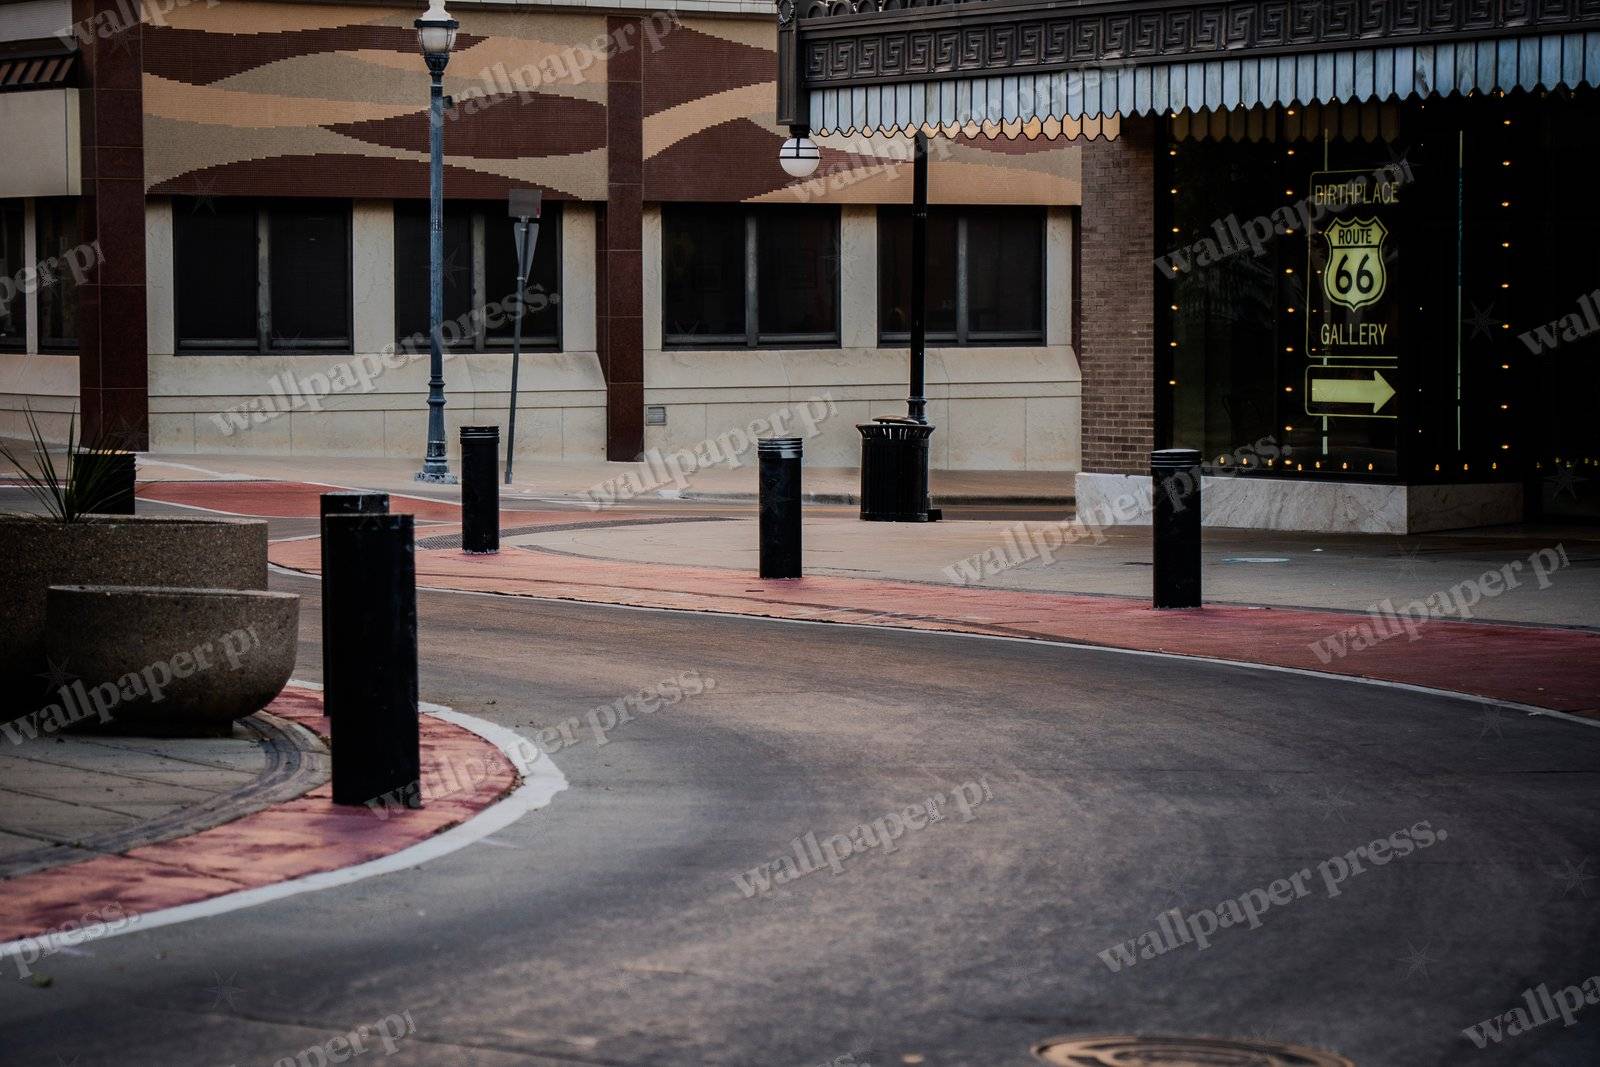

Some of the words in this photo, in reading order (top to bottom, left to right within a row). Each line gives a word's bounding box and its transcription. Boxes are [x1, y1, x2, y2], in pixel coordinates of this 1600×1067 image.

[1315, 182, 1399, 206] BIRTHPLACE
[1339, 228, 1372, 245] ROUTE
[1335, 254, 1374, 294] 66
[1321, 323, 1388, 345] GALLERY
